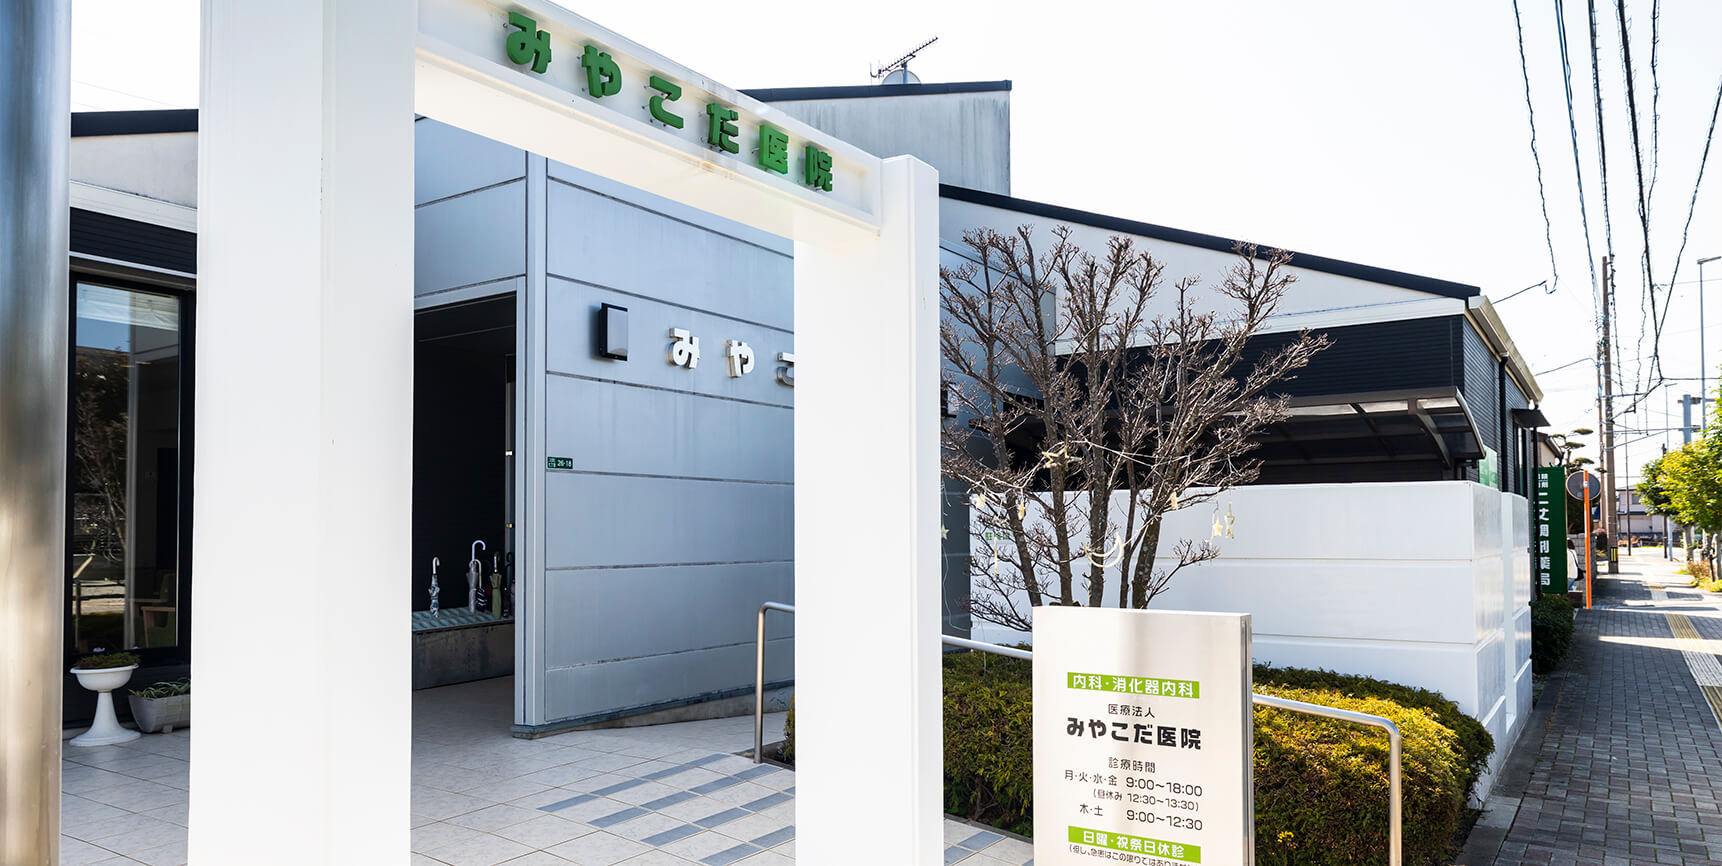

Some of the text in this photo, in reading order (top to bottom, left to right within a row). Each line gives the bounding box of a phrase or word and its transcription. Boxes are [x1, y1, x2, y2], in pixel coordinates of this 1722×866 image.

[506, 11, 832, 192] みやこだ医院
[1073, 675, 1193, 697] 内科・消化器内科
[1108, 703, 1155, 719] 医療法人
[1066, 717, 1201, 750] みやこだ医院
[1108, 756, 1156, 774] 診療時間
[1079, 802, 1103, 817] 木・土
[1083, 830, 1184, 859] 日曜・祝祭日休診
